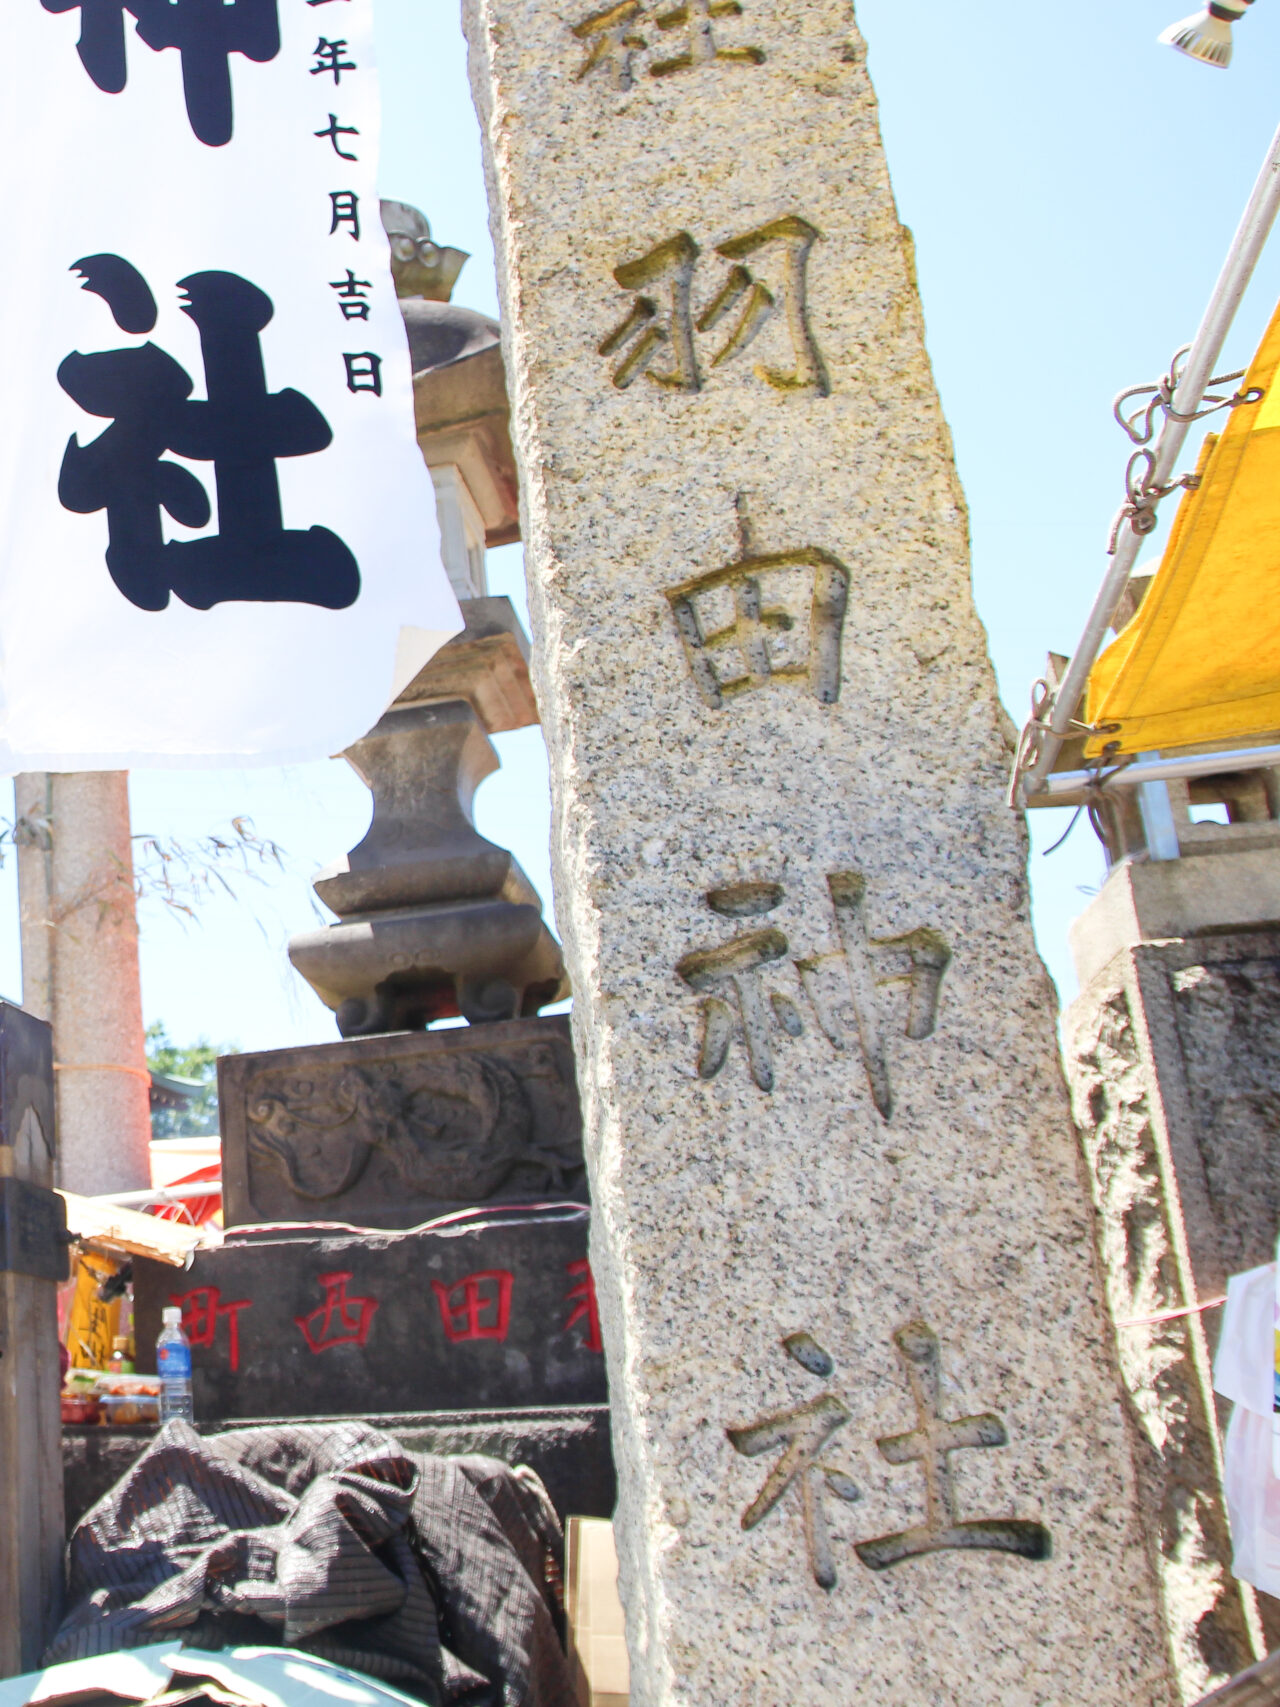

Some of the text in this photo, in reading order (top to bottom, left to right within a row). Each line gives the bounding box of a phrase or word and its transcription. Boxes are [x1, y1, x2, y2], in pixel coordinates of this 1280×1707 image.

[306, 0, 383, 398] 年七月吉日
